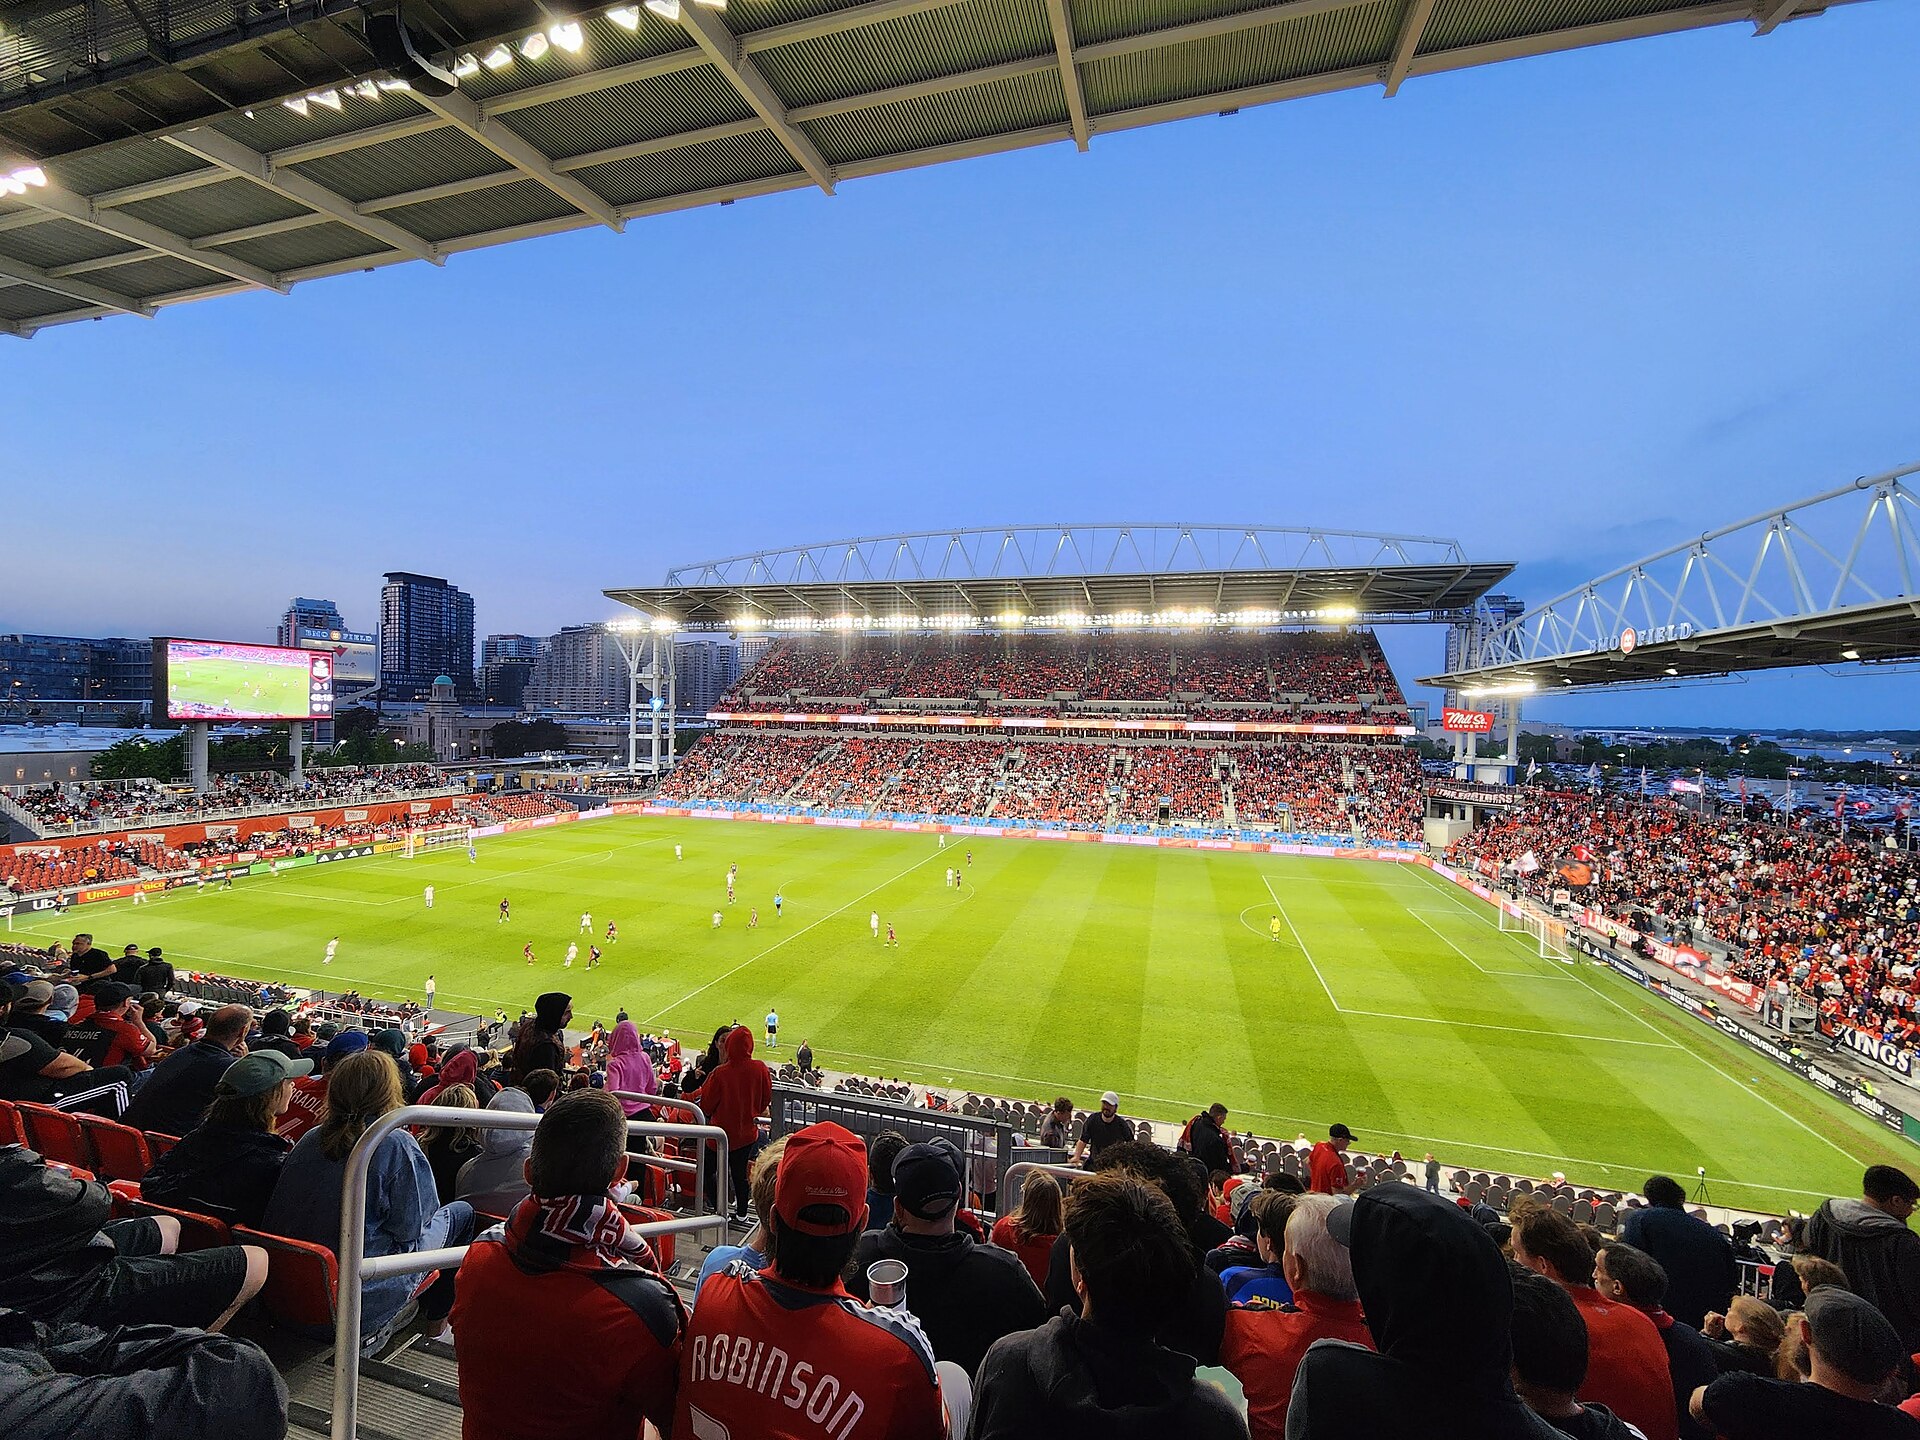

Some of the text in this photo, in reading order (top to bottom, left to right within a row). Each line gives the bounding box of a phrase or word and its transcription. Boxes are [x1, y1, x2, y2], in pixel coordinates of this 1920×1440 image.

[305, 629, 373, 642] BMO FIELD
[1589, 622, 1693, 653] BMO FIELD
[638, 711, 674, 719] FANDUEL
[1446, 712, 1473, 725] Mill
[86, 880, 165, 901] Unico nico
[32, 895, 70, 911] Ubr
[1739, 1028, 1792, 1064] CHEVROLET
[1843, 1025, 1911, 1073] KINGS
[691, 1333, 865, 1440] ROBINSON
